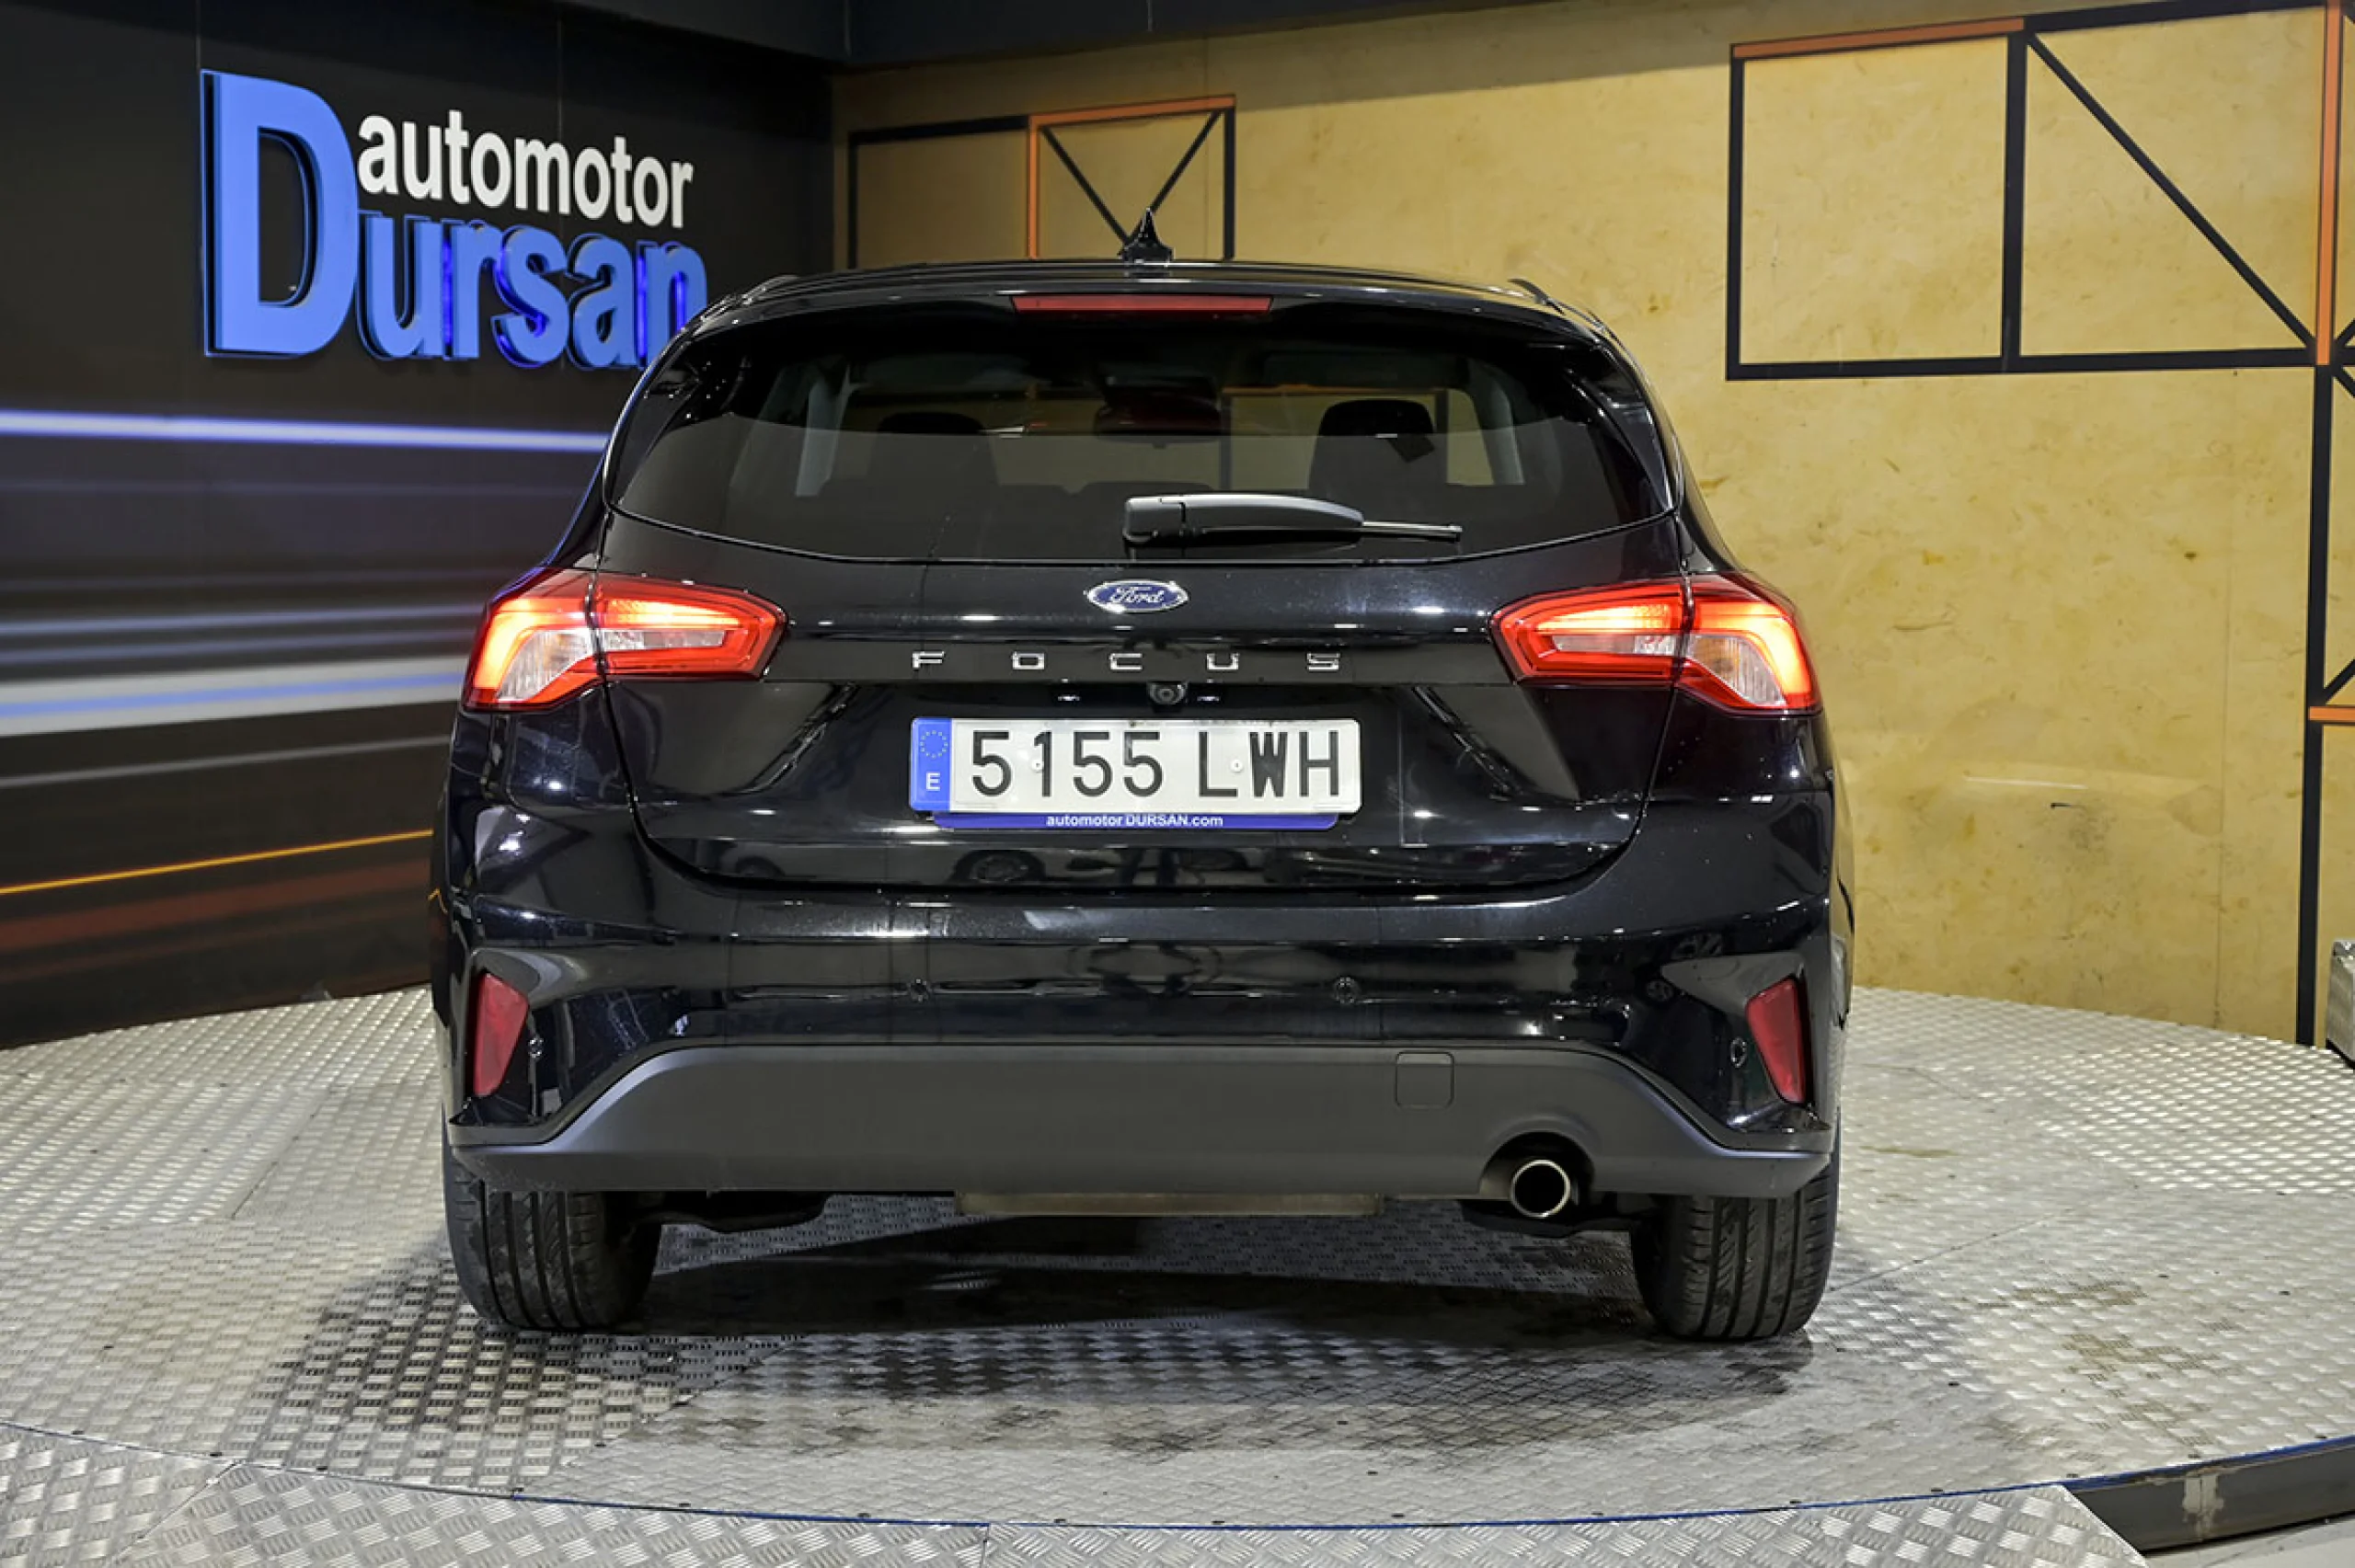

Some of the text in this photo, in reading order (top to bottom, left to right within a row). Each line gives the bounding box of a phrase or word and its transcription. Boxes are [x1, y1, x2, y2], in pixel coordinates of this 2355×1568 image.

[357, 109, 695, 228] automotor
[201, 69, 707, 369] Dursan
[1109, 585, 1166, 604] Ford
[912, 650, 1341, 671] FOCUS
[925, 773, 940, 791] E
[971, 730, 1340, 798] 5155 LWH
